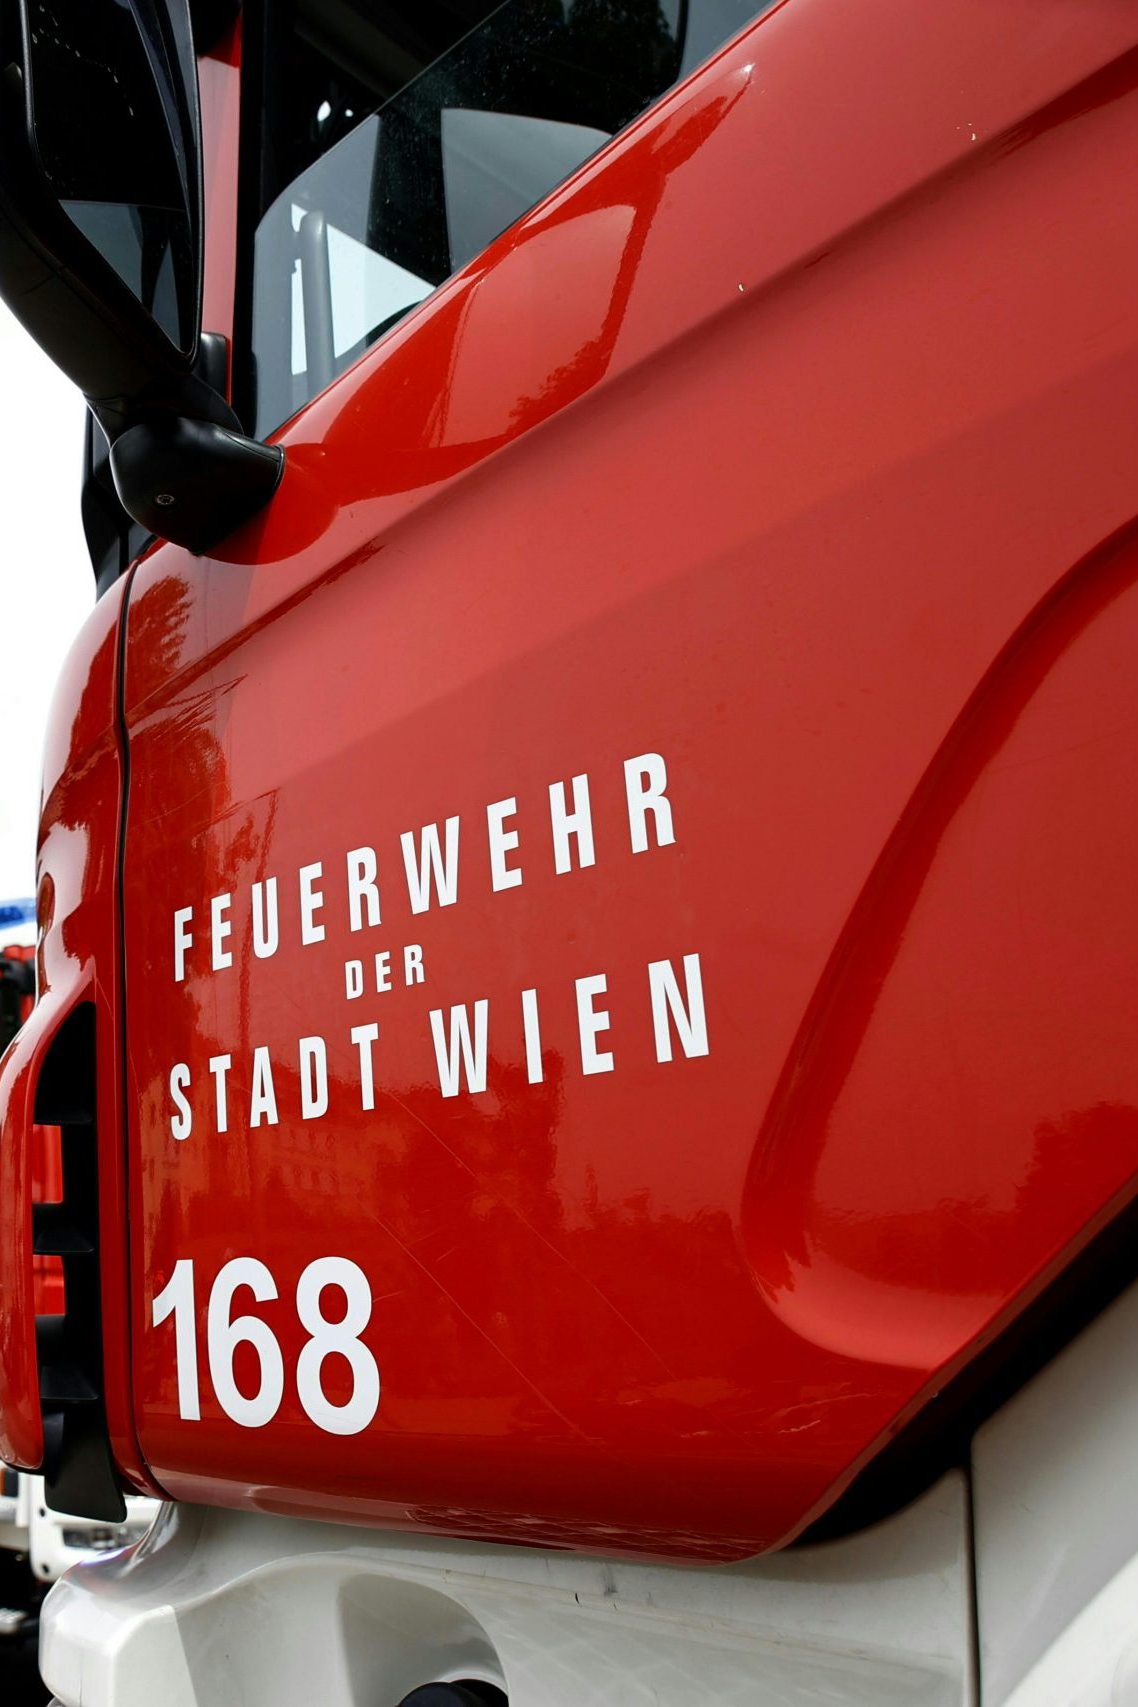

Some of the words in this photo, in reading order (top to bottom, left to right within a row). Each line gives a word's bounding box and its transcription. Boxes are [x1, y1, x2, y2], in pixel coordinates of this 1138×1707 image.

[173, 752, 677, 983] FEUERWEHR
[169, 1022, 379, 1141] STADT
[429, 953, 711, 1099] WIEN
[344, 943, 426, 1001] DER
[151, 1255, 381, 1436] 168
